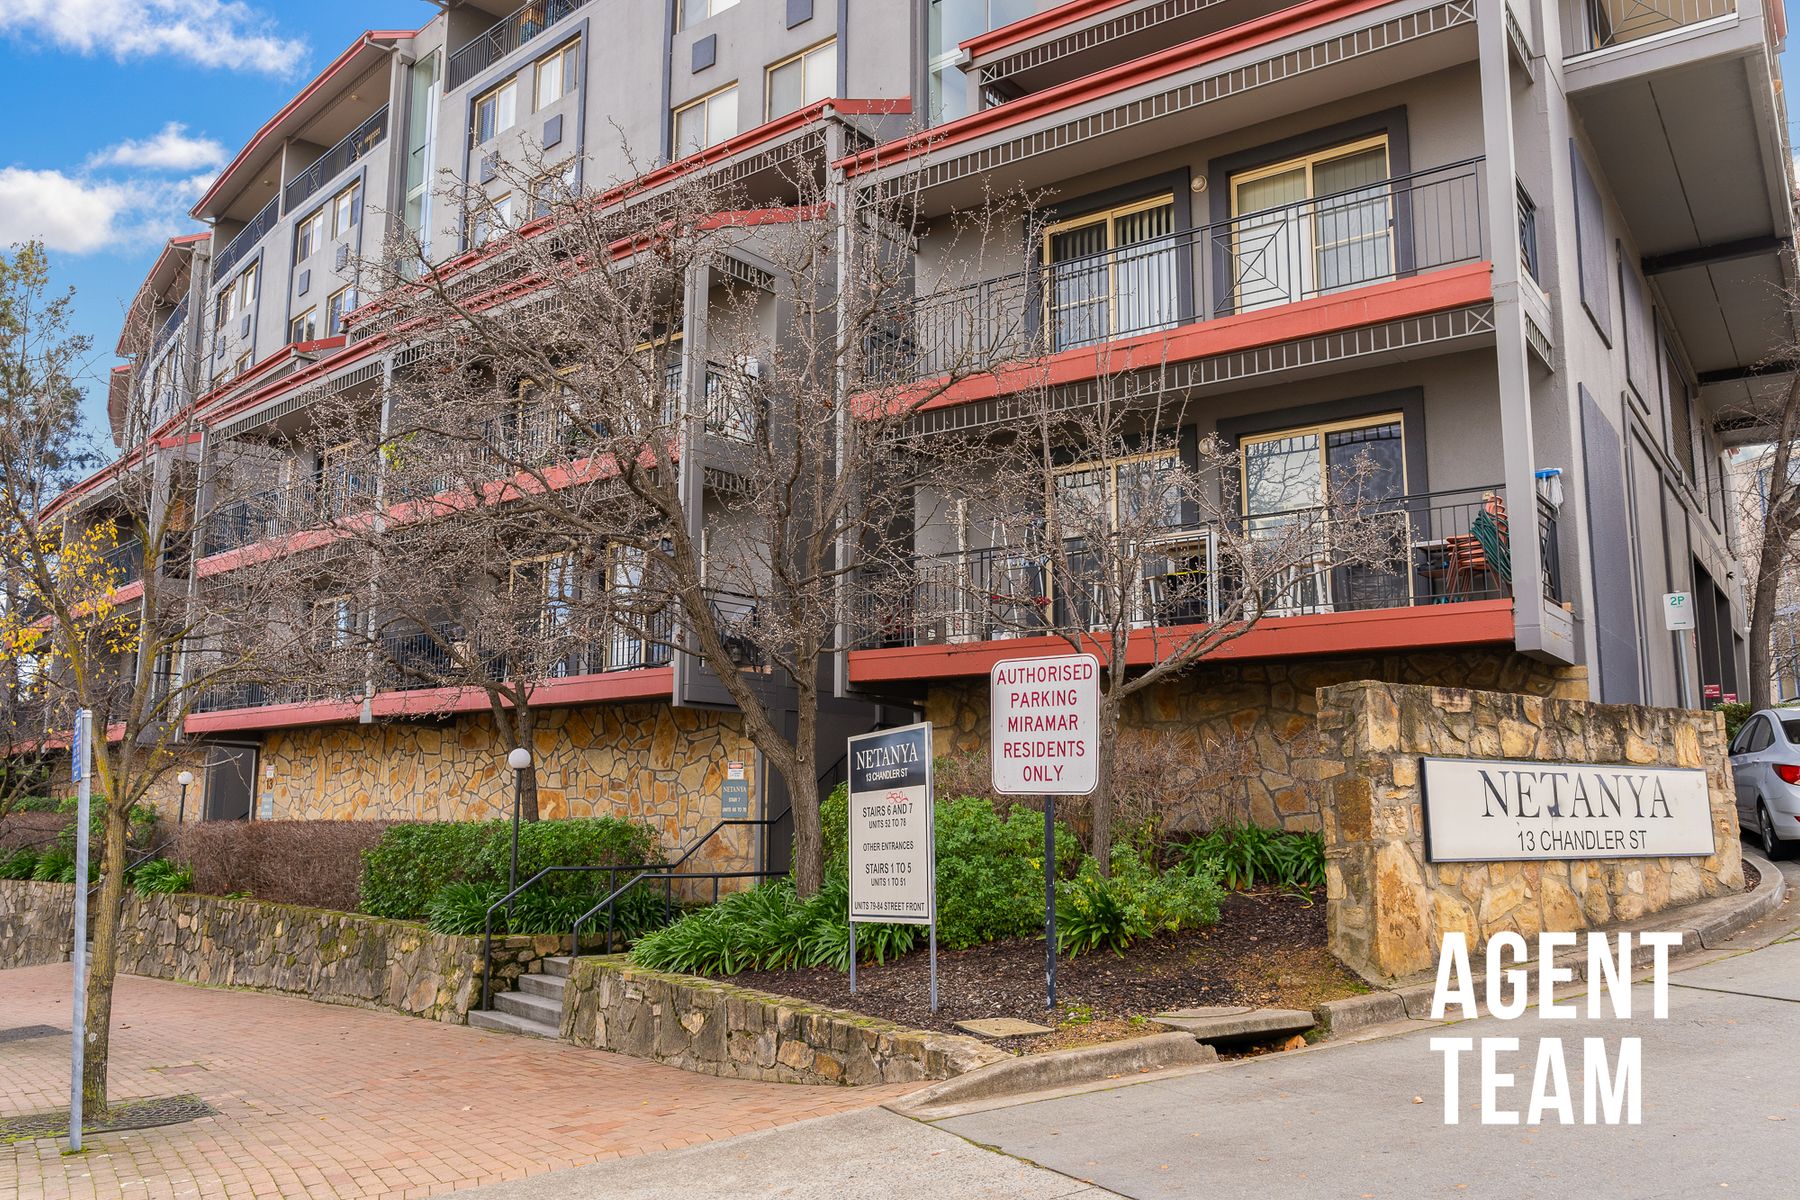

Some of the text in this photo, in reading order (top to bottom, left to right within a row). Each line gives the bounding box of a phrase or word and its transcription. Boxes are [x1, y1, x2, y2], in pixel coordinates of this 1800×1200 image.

[1671, 596, 1685, 605] 2P
[997, 663, 1093, 685] AUTHORISED
[1010, 689, 1077, 708] PARKING
[1008, 714, 1078, 732] MIRAMAR
[856, 742, 918, 770] NETANYA
[1004, 740, 1085, 758] RESIDENTS
[865, 767, 908, 782] 13 CHANDLER ST
[1023, 764, 1064, 782] ONLY
[1478, 769, 1674, 819] NETANYA
[863, 803, 913, 817] STAIRS 6 AND 7
[869, 819, 884, 828] UNITS
[885, 819, 891, 828] 52
[892, 818, 899, 827] TO
[863, 840, 914, 851] OTHER ENTRANCES
[1517, 830, 1647, 852] 13 CHANDLER ST
[865, 862, 912, 874] STAIRS 1 TO 5
[870, 877, 906, 887] UNITS 1 TO 51
[854, 901, 925, 911] UNITS 79-84 STREET FRONT
